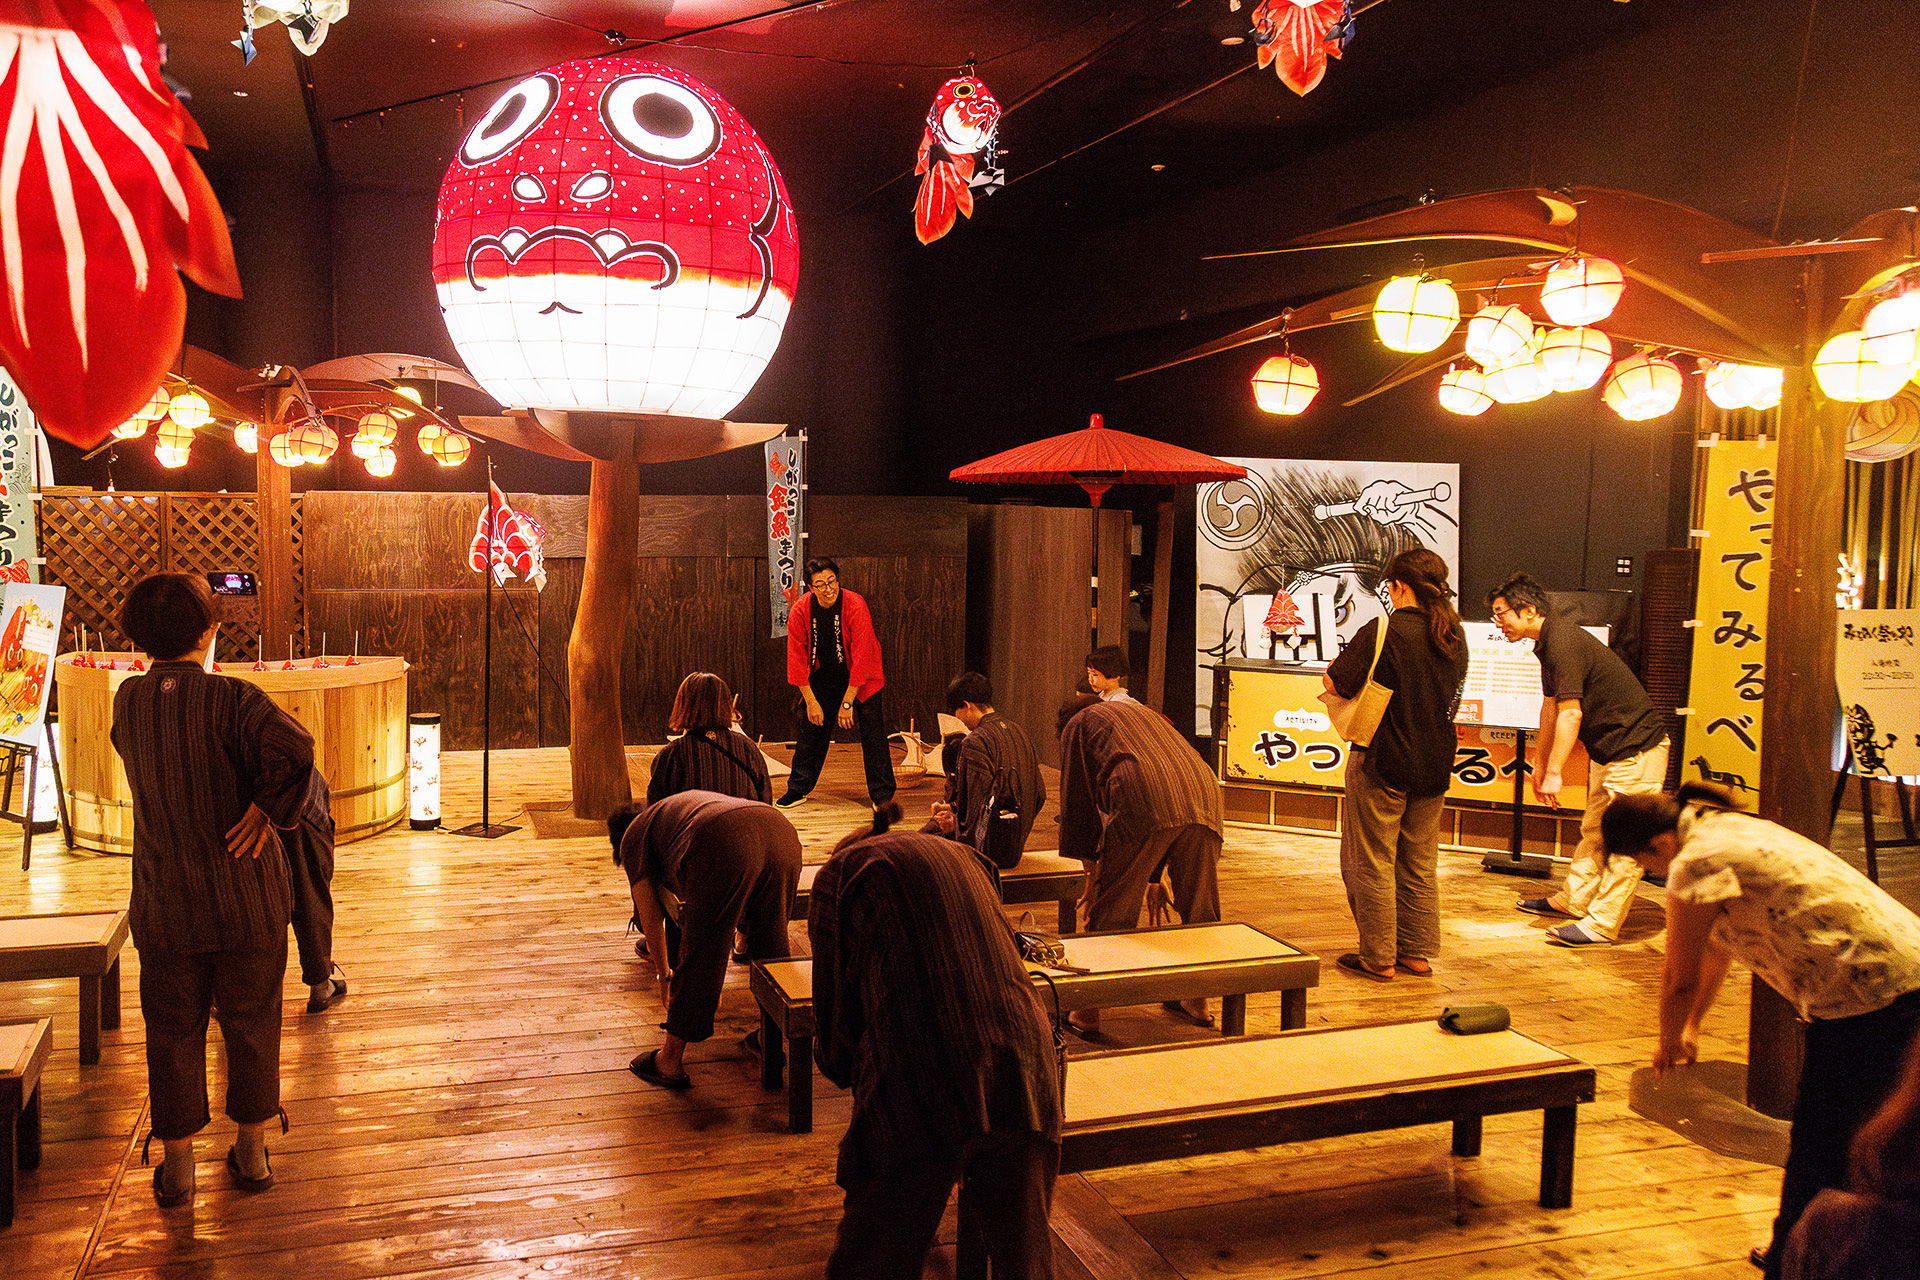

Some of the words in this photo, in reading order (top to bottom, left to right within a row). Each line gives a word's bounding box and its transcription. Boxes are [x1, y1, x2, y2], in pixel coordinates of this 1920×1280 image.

[784, 448, 798, 517] しがっこ
[767, 484, 794, 590] 金魚まつり
